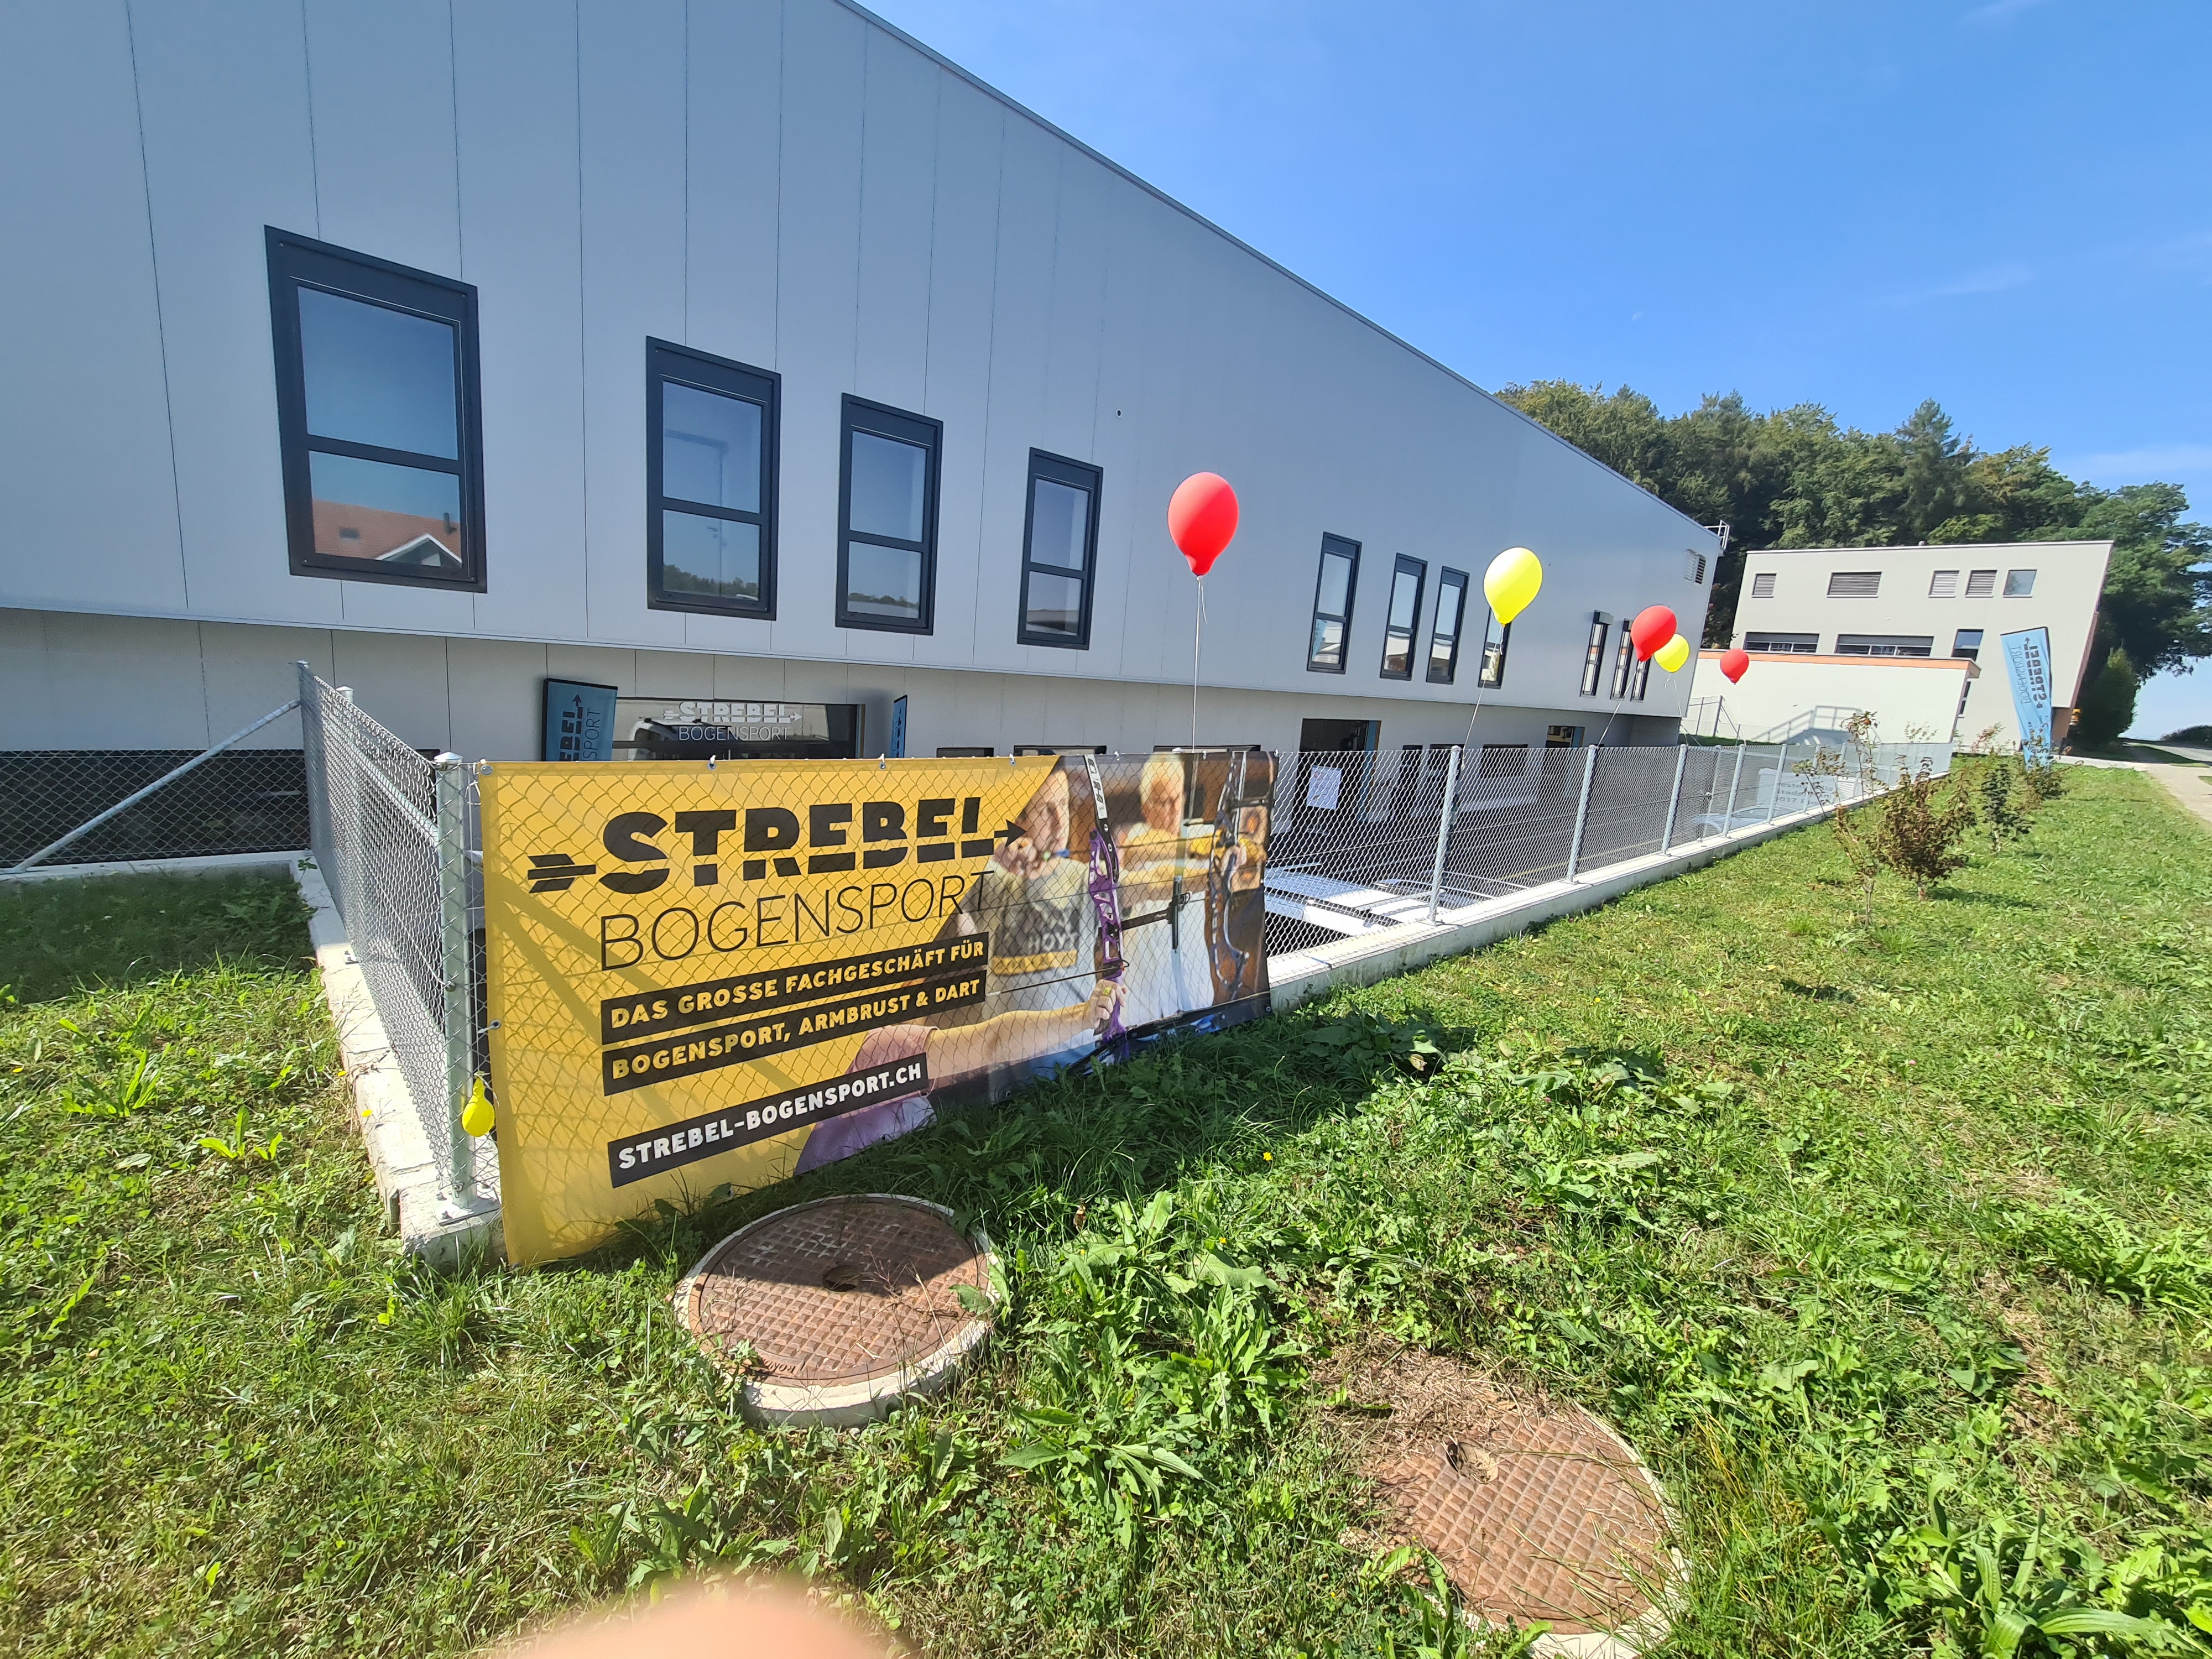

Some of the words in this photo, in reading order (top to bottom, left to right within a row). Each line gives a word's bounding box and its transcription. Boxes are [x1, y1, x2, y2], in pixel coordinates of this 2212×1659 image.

[559, 706, 583, 761] EBEL
[583, 708, 601, 760] SPORT
[678, 726, 790, 741] BOGENSPORT
[679, 701, 791, 723] STREBEL
[598, 797, 995, 894] STREBEL
[600, 871, 994, 971] BOGENSPORT
[611, 1000, 668, 1029] DAS
[677, 980, 778, 1014] GROSSE
[784, 948, 945, 993] FACHGESCHÄFT
[950, 941, 984, 962] FÜR
[612, 1023, 792, 1079] BOGENSPORT,
[797, 998, 911, 1036] ARMBRUST
[915, 990, 928, 1008] &
[935, 979, 980, 1002] DART
[618, 1062, 922, 1169] STREBEL-BOGENSPORT.CH
